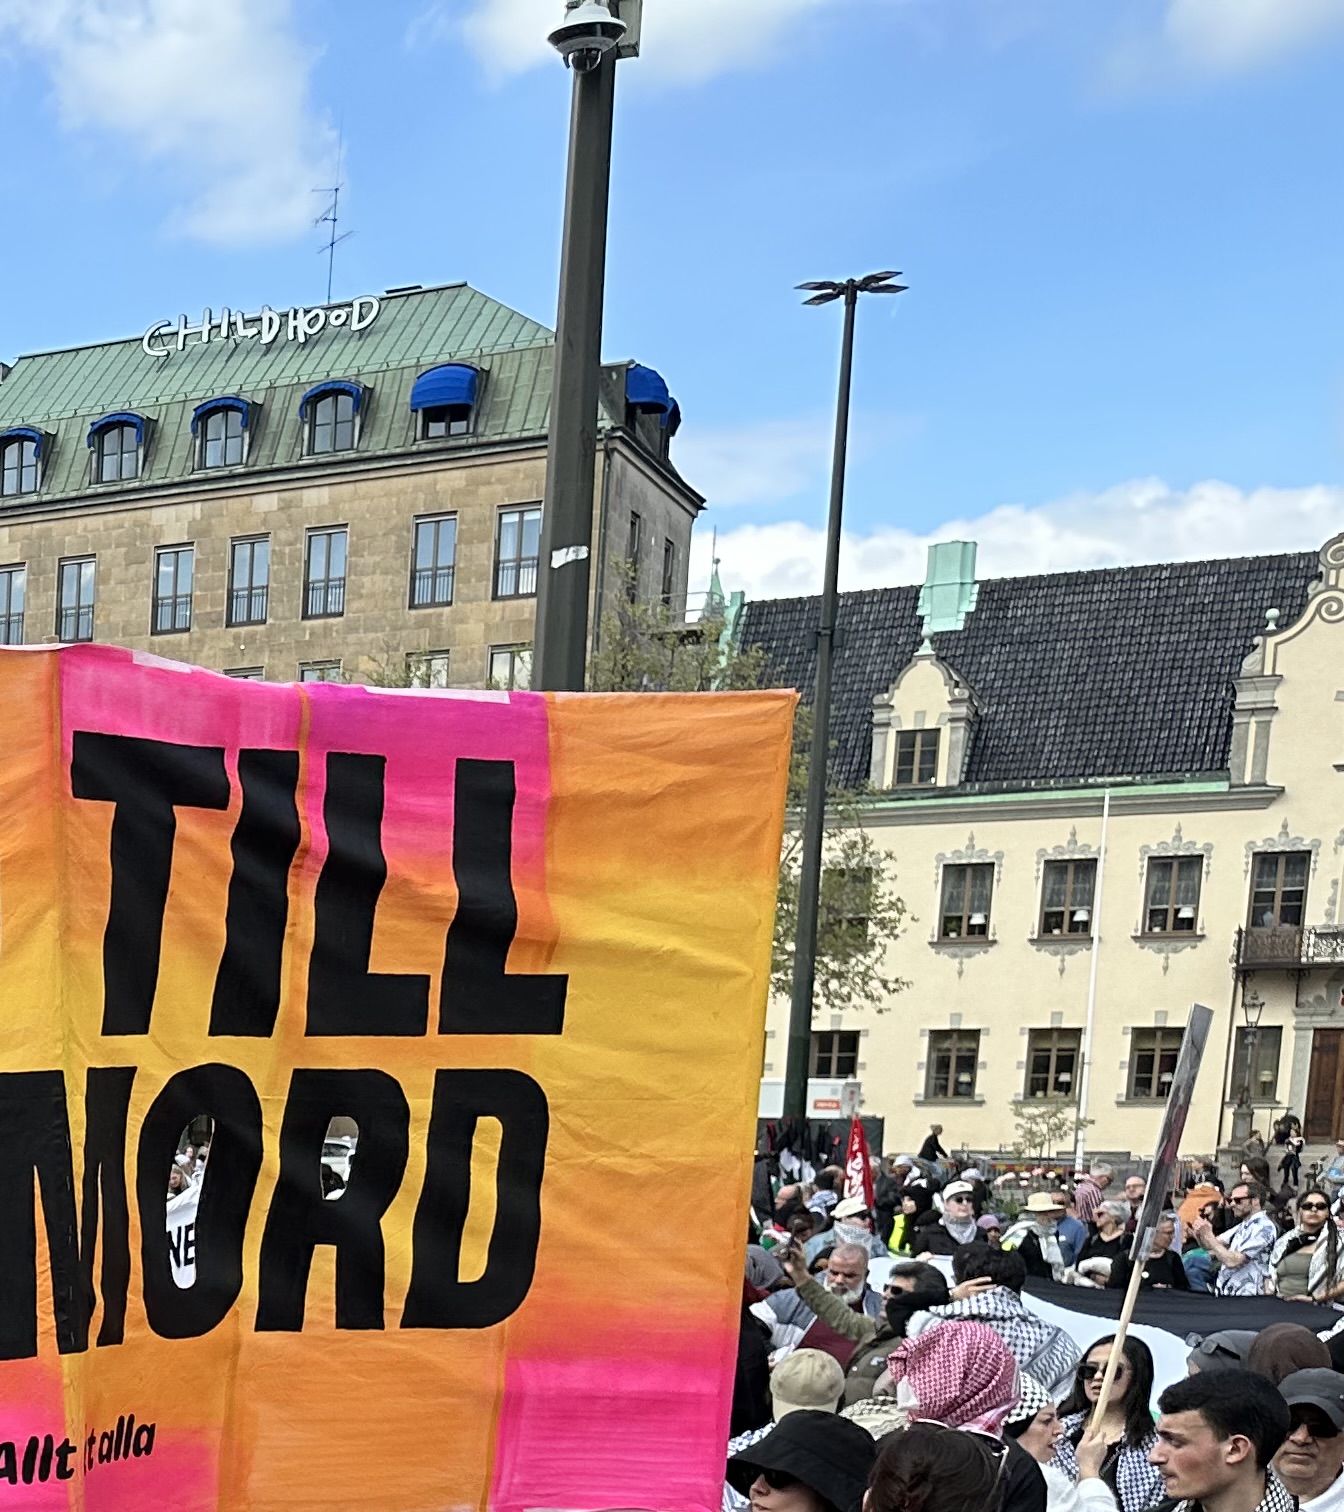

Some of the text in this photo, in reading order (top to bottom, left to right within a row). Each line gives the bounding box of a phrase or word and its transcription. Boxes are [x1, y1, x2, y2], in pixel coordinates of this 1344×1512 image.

[141, 295, 381, 357] CHILDHOOD
[70, 730, 569, 1038] TILL
[98, 1413, 157, 1464] alla
